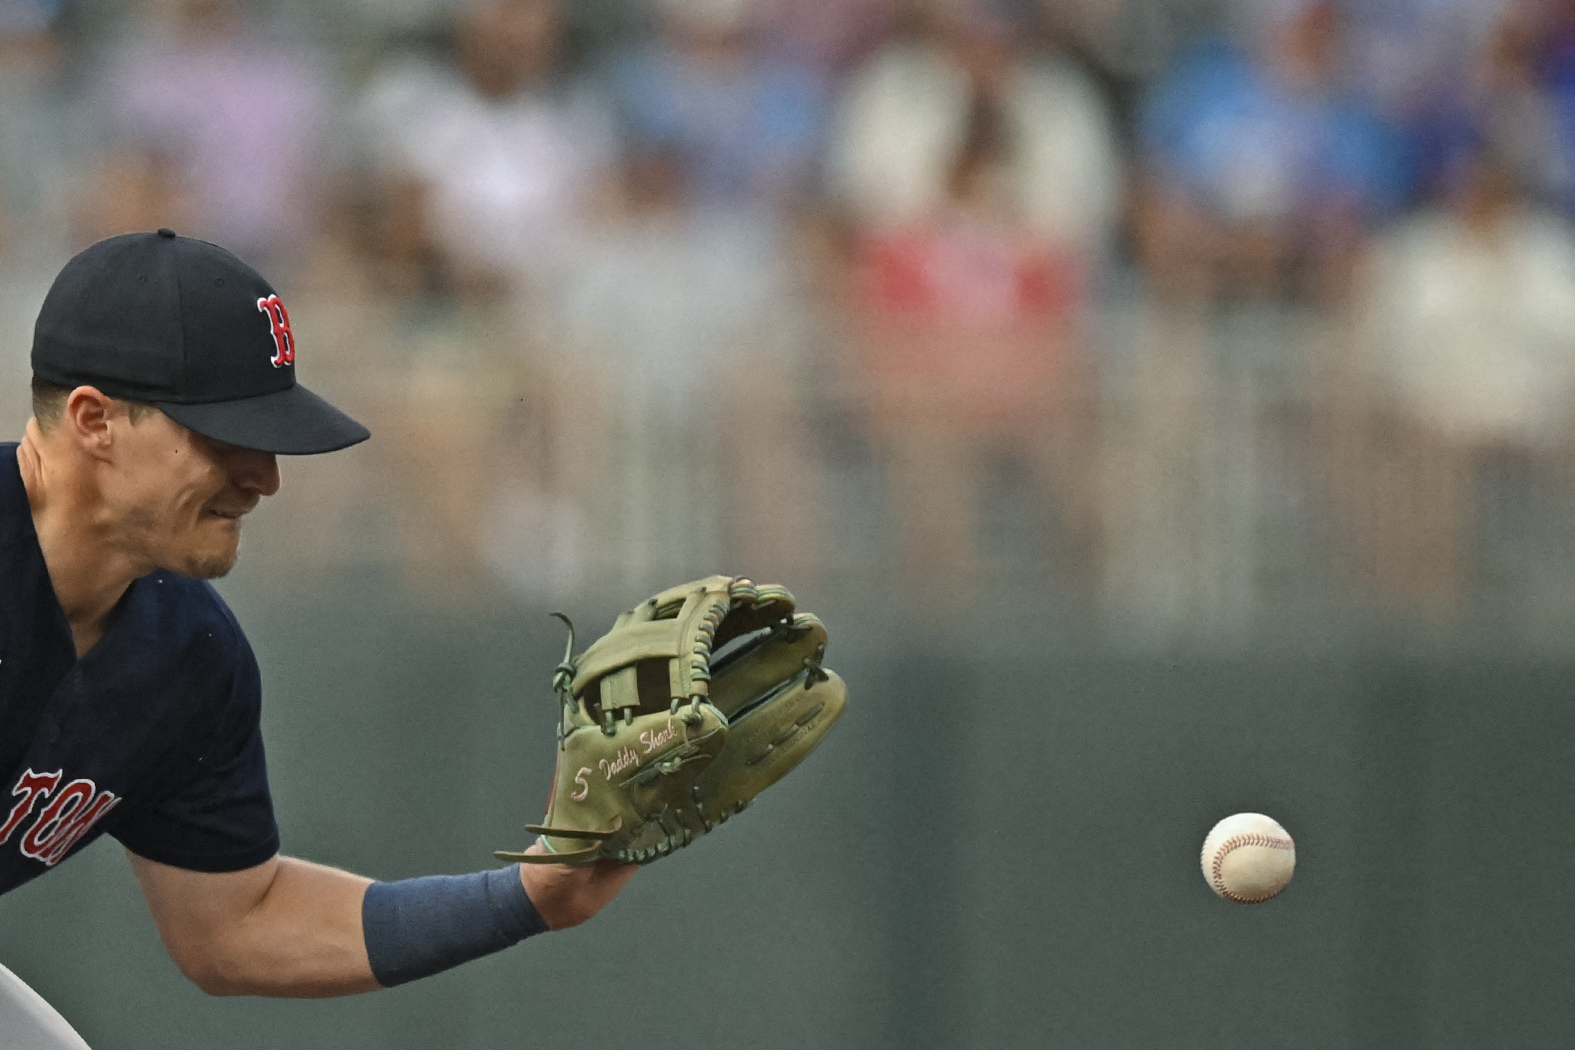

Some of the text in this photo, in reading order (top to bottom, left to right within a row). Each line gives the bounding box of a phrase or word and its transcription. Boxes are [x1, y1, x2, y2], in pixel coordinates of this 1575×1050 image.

[257, 293, 296, 368] B
[598, 717, 678, 781] Daddy Shark
[570, 766, 593, 801] 5
